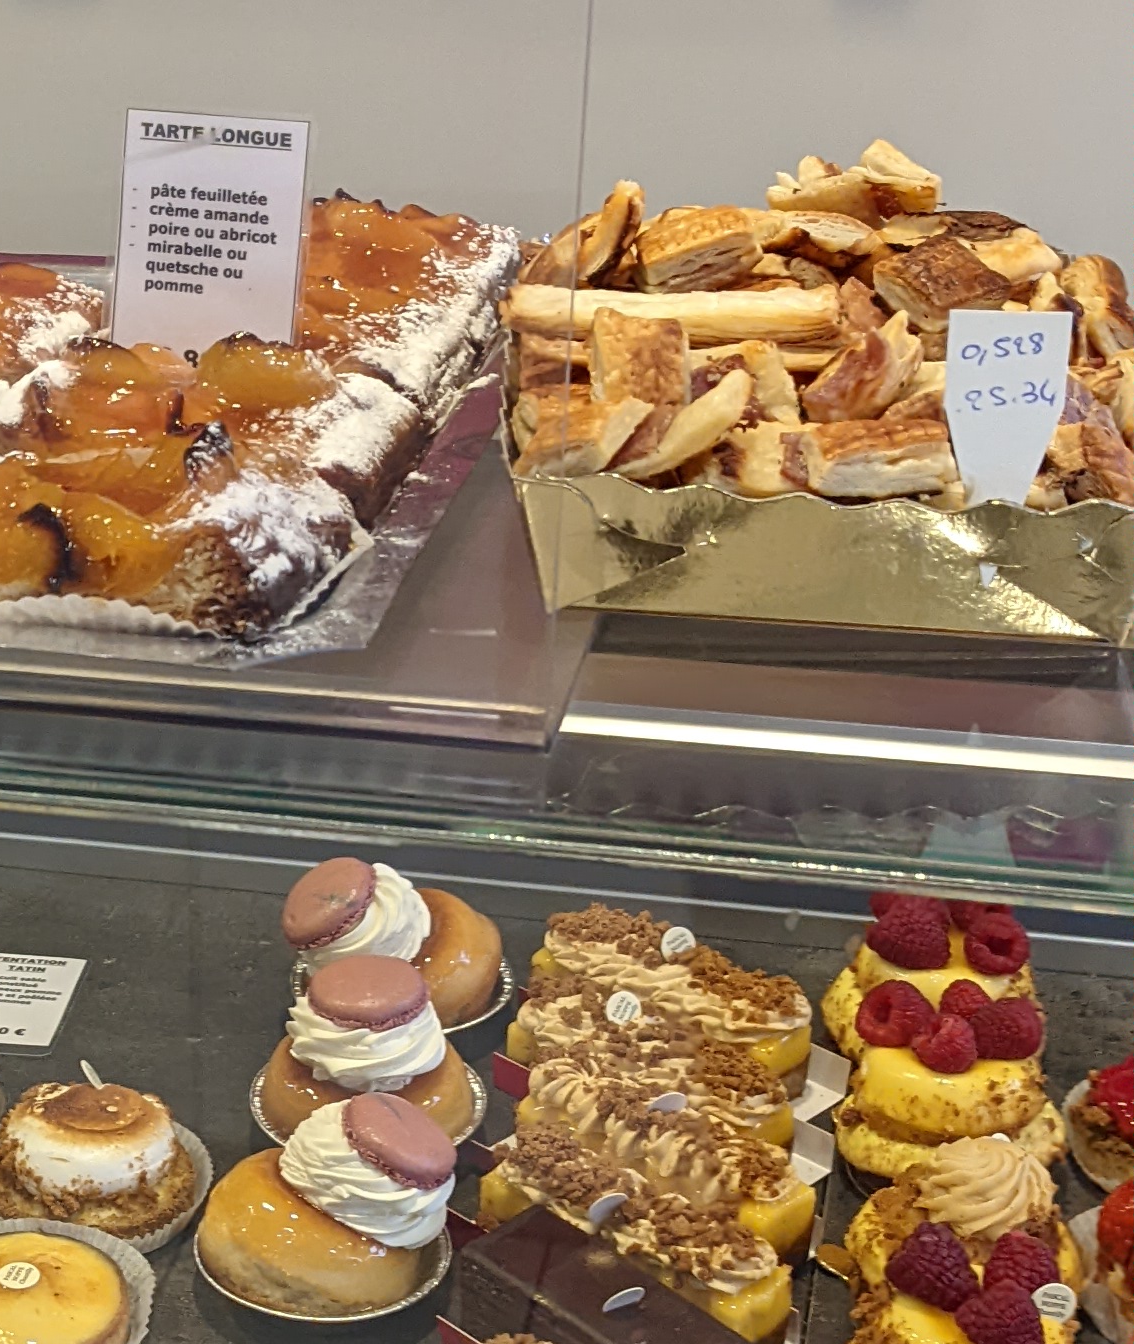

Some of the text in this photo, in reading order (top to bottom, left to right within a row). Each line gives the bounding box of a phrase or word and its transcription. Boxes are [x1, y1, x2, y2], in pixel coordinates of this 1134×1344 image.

[150, 182, 268, 207] pâte feuilletée
[149, 201, 270, 226] crème amande
[148, 221, 278, 246] poire ou abricot
[147, 239, 248, 261] mirabelle ou
[145, 260, 243, 280] quetsche ou
[144, 279, 204, 295] pomme
